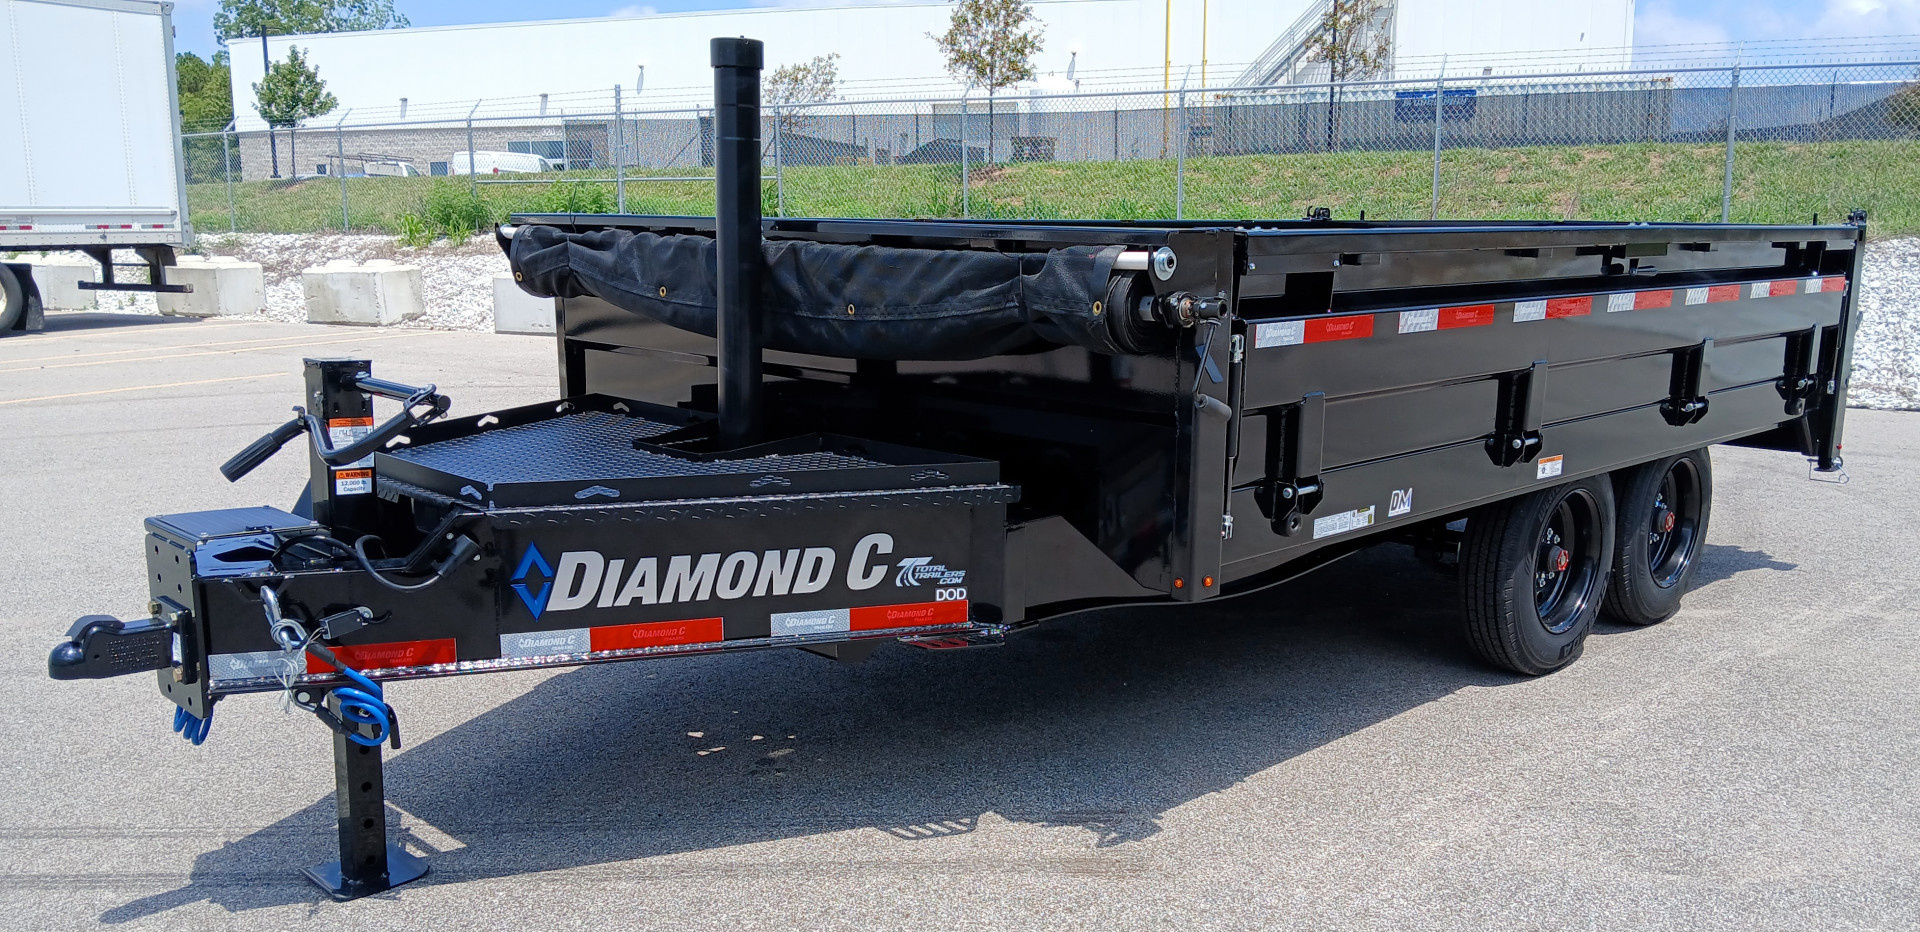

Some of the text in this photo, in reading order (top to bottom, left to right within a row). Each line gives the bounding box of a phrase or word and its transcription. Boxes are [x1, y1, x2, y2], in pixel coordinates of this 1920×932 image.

[1391, 489, 1412, 511] DM
[545, 532, 894, 612] DIAMOND C
[914, 571, 966, 579] TRAILERS
[937, 577, 963, 585] .COM
[936, 588, 967, 601] DOD
[891, 608, 934, 619] DIAMOND C
[790, 615, 836, 627] DIAMOND C
[637, 626, 686, 639] DIAMOND C
[524, 635, 577, 647] DIAMOND C
[361, 648, 414, 660] DIAMOND C
